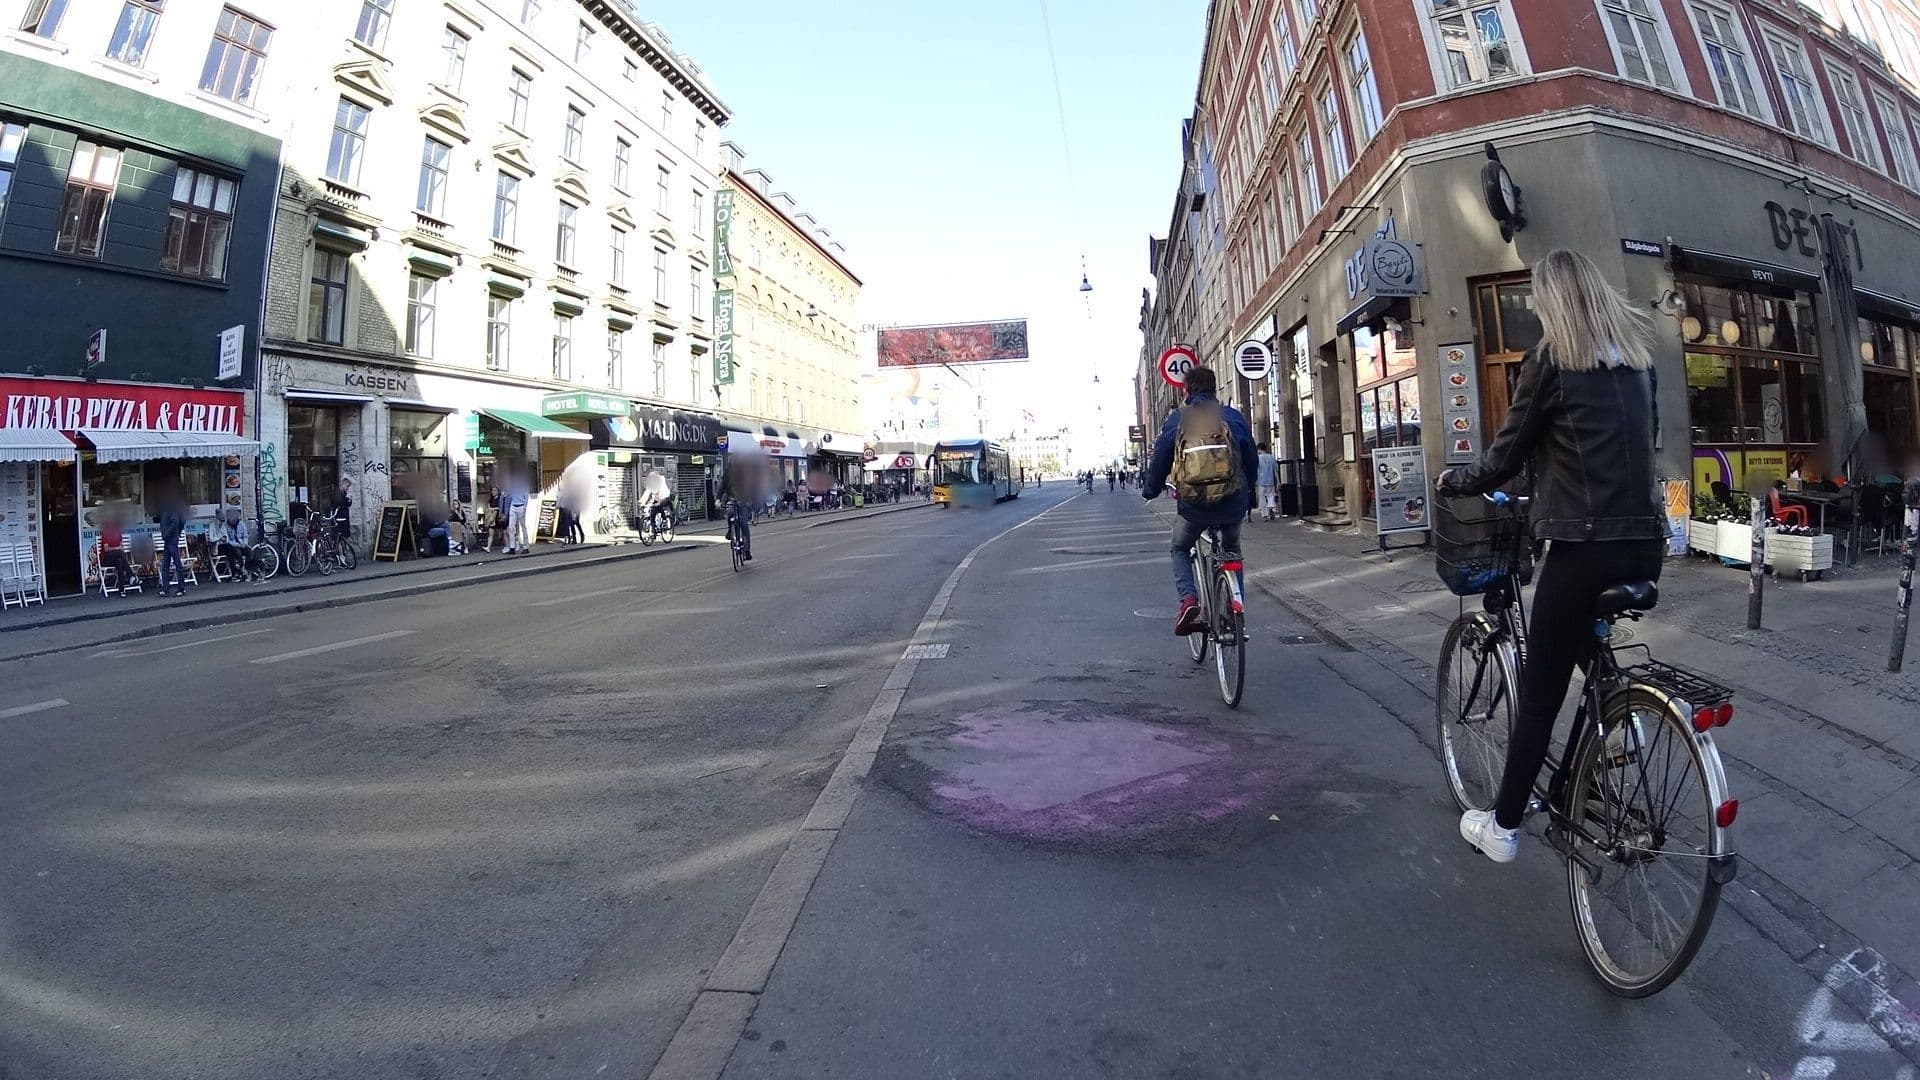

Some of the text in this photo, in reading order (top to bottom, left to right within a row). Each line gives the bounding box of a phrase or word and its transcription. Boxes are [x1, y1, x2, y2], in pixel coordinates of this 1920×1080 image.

[717, 192, 731, 273] HOTEL
[1763, 201, 1863, 271] BETI
[719, 294, 732, 379] Hotel Nora
[345, 373, 407, 392] KASSEN
[1168, 360, 1191, 375] 40
[85, 398, 148, 430] PIZZA
[156, 401, 173, 431] &
[177, 402, 239, 434] GRILL
[546, 399, 578, 411] HOTEL
[639, 418, 707, 443] MALING.DK
